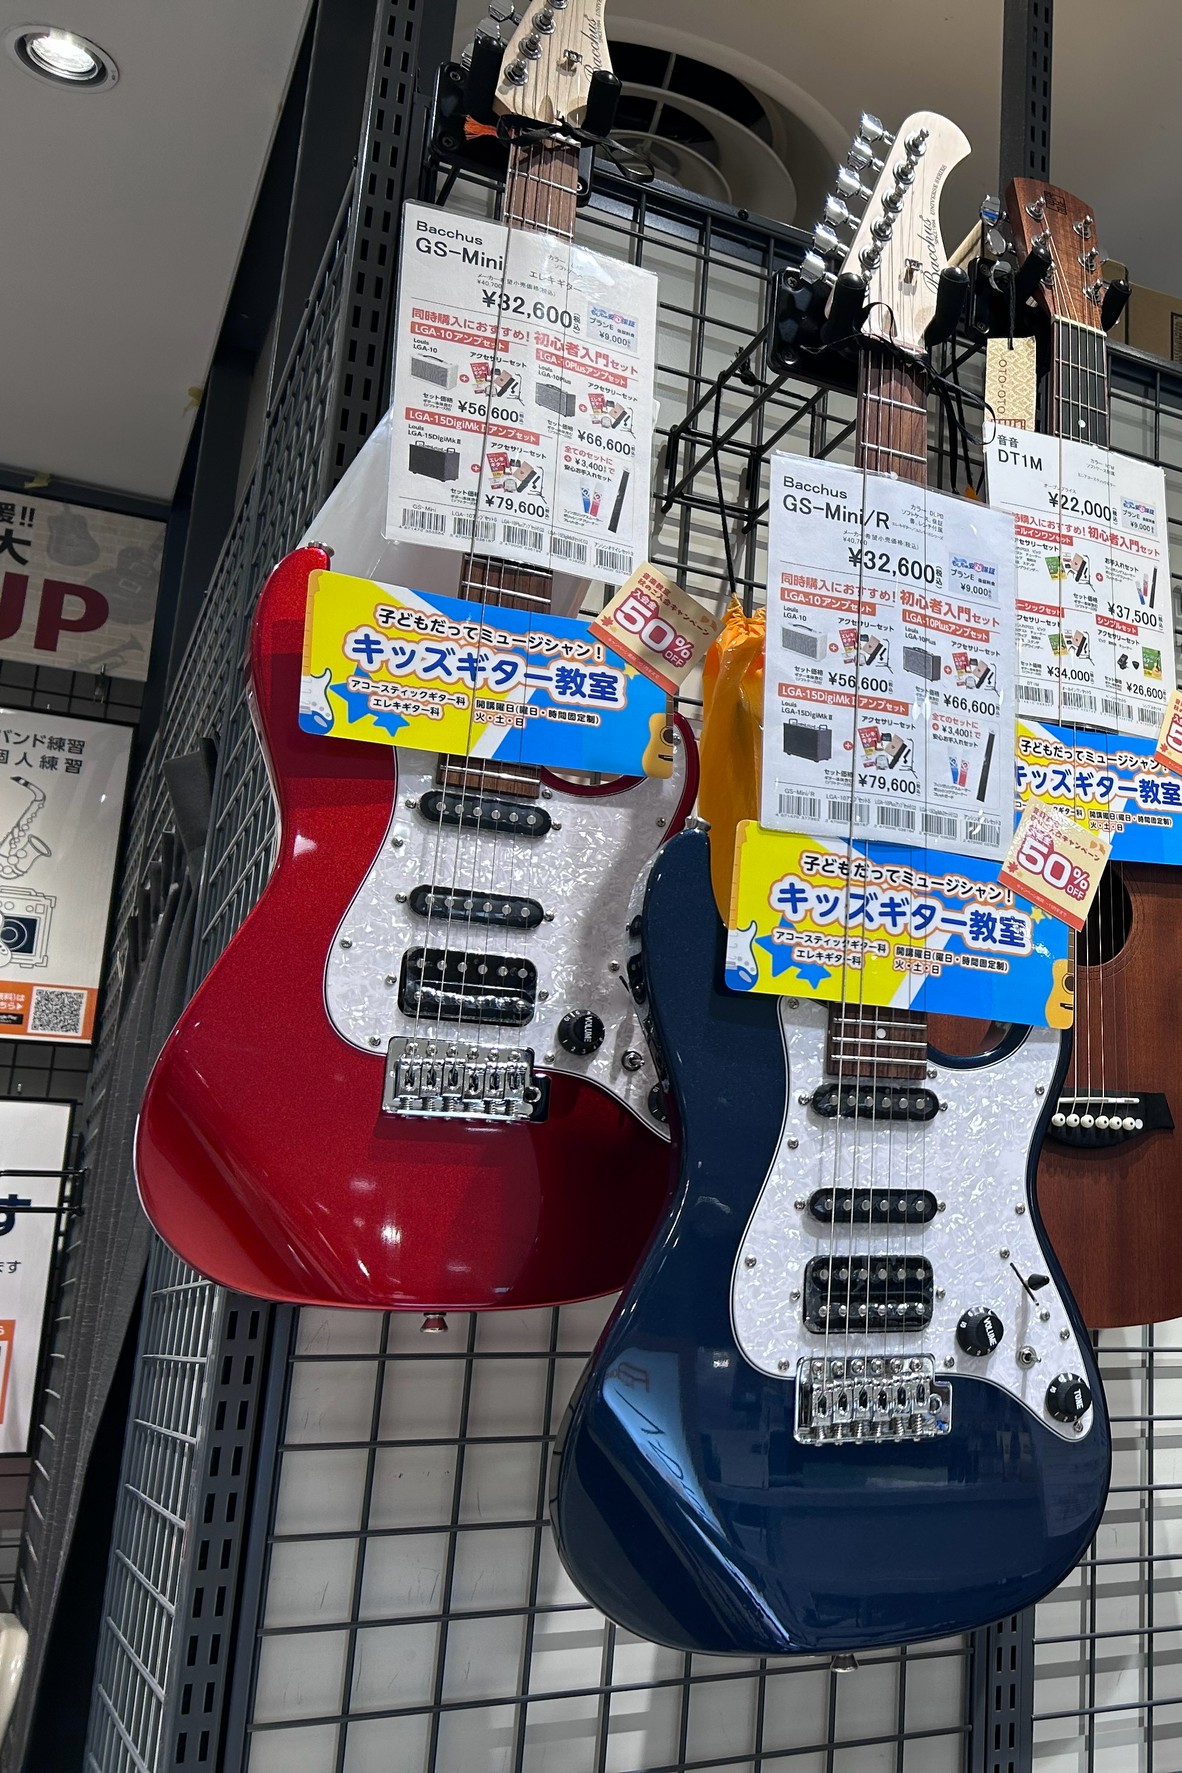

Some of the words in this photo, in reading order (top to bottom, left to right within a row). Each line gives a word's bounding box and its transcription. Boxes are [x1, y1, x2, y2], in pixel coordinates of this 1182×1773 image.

[416, 220, 483, 246] Bacchus
[416, 237, 503, 271] GS-Mini
[481, 288, 573, 329] ¥32,600
[412, 307, 529, 343] 同時購入におすすめ!
[534, 330, 639, 376] 初心者入門セット
[413, 338, 430, 346] Louis
[413, 344, 438, 354] LGA-10
[415, 325, 506, 351] LGA-10アンプセット
[469, 351, 527, 369] アクセサリーセット
[588, 382, 639, 402] アクセサリーセット
[997, 358, 1008, 415] OTO-OTO
[490, 442, 547, 460] アクセサリーセット
[577, 429, 631, 456] ¥66,600
[997, 434, 1019, 449] 音音
[565, 445, 614, 466] 全てのセットに
[575, 457, 604, 473] ¥3,400
[997, 449, 1043, 472] DT1M
[783, 475, 848, 500] Bacchus
[485, 494, 545, 518] ¥79,600
[783, 494, 890, 530] GS-Mini/R
[1048, 491, 1112, 522] ¥22,000
[1088, 525, 1161, 556] 初心者入門セット
[848, 546, 935, 584] ¥32,600
[781, 573, 896, 603] 同時購入におすすめ!
[900, 589, 1000, 627] 初心者入門セット
[959, 581, 989, 597] ¥9,000
[783, 605, 799, 613] Louis
[784, 592, 872, 613] LGA-10アンプセット
[783, 612, 807, 622] LGA-10
[838, 617, 895, 632] アクセサリーセット
[1097, 616, 1137, 635] シンプルセット
[1107, 601, 1158, 628] ¥37,500
[378, 607, 603, 660] 子どもだってミュージシャン!
[615, 596, 693, 659] 50%
[905, 614, 988, 641] LGA-10Plusアンプセット
[665, 651, 684, 666] OFF
[951, 641, 1001, 657] アクセサリーセット
[352, 633, 619, 703] キッズギター教室
[1046, 666, 1090, 682] ¥34,000
[351, 679, 466, 706] アコースティックギター科
[1126, 682, 1164, 701] ¥26,600
[372, 698, 440, 717] エレキギター科
[476, 699, 600, 726] 開講曜日(曜日・時間固定制)
[943, 693, 996, 716] ¥66,600
[476, 712, 524, 728] 火・土・日
[861, 715, 917, 730] アクセサリーセット
[932, 712, 979, 729] 全てのセットに
[942, 724, 970, 738] ¥3,400
[858, 773, 916, 795] ¥79,600
[1018, 836, 1089, 890] 50%
[804, 855, 1014, 903] 子どもだってミュージシャン!
[1066, 884, 1084, 899] OFF
[777, 882, 1026, 948] キッズギター教室
[796, 950, 862, 966] エレキギター科
[895, 959, 940, 974] 火・土・日
[896, 945, 1009, 972] 開講曜日(曜日・時間固定制)
